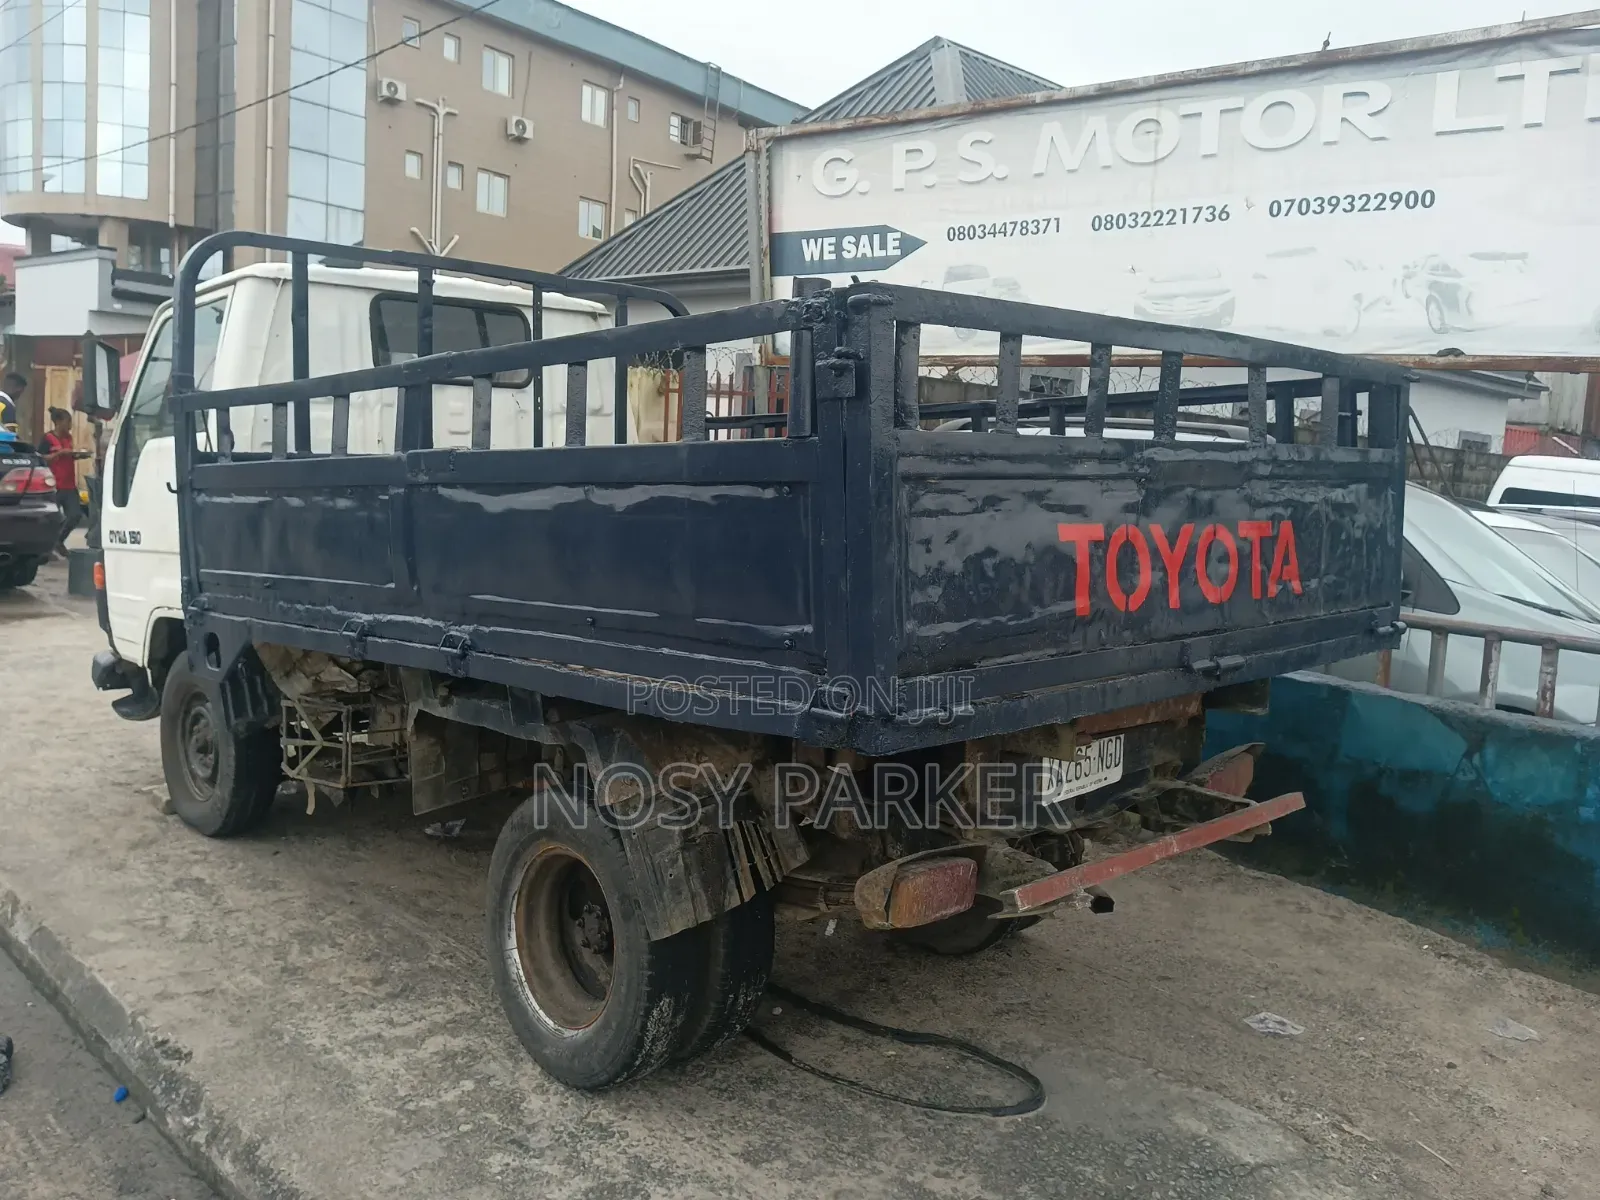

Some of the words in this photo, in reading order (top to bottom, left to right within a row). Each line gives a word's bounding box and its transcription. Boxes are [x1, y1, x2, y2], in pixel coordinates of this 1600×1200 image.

[811, 148, 871, 197] G.
[892, 140, 938, 192] P.
[957, 131, 1010, 184] S.
[1032, 80, 1392, 178] MOTOR
[1433, 53, 1600, 136] LT
[801, 237, 837, 262] WE
[841, 231, 901, 259] SALE
[946, 216, 1063, 242] 08034478371
[1091, 203, 1231, 232] 08032221736
[1268, 189, 1436, 218] 07039322900
[1057, 520, 1303, 616] TOYOTA
